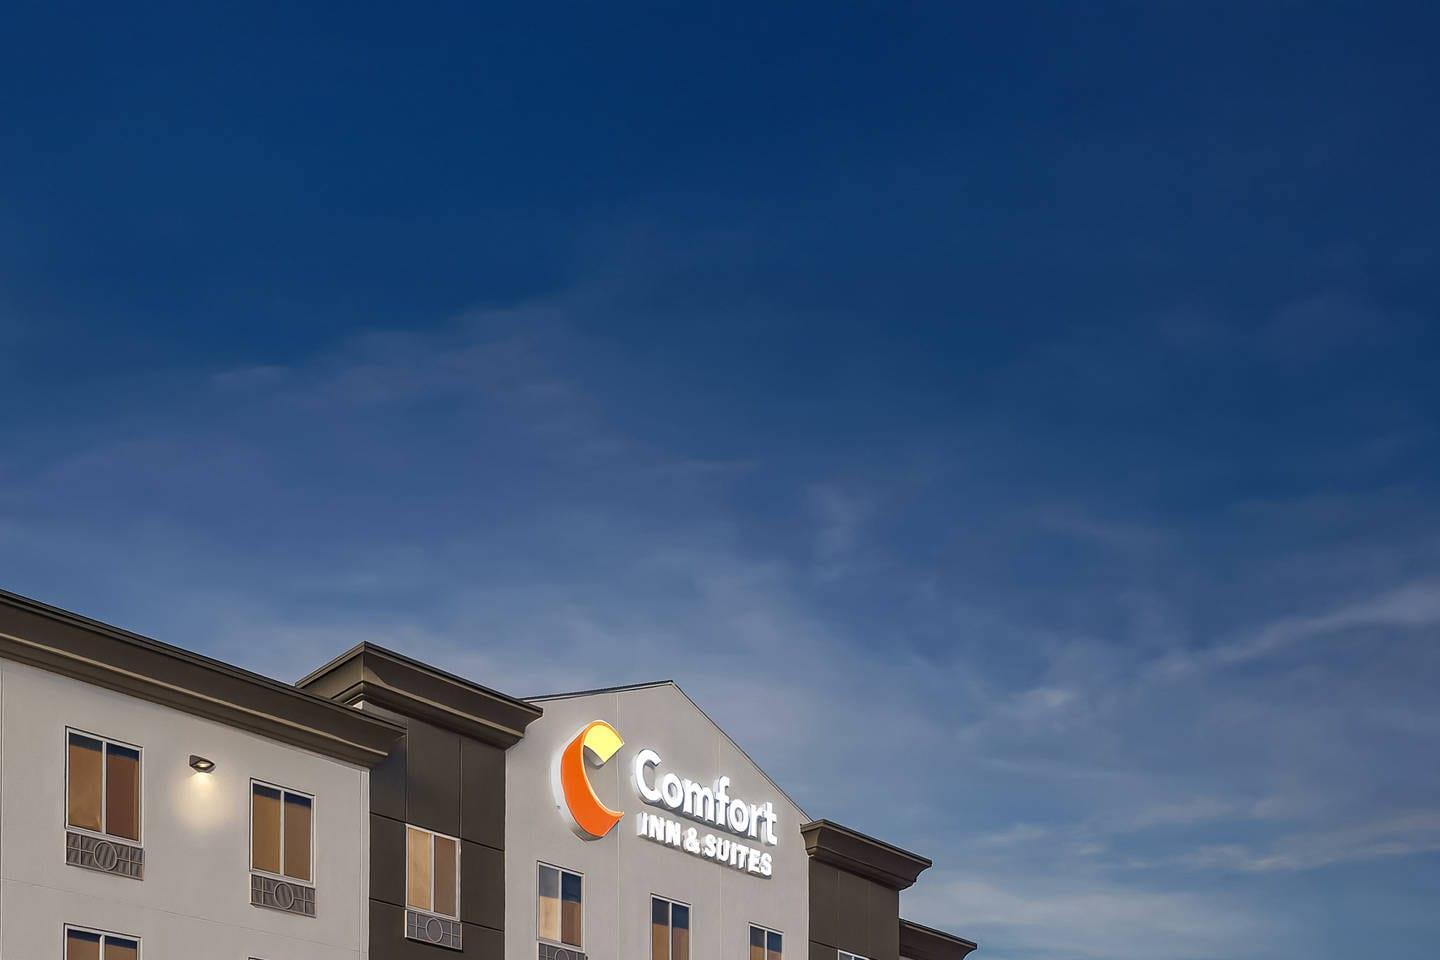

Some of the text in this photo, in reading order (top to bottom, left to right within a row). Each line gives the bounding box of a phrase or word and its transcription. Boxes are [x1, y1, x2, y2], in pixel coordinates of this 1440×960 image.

[635, 749, 778, 846] Comfort
[637, 812, 772, 876] INN & SUITES
